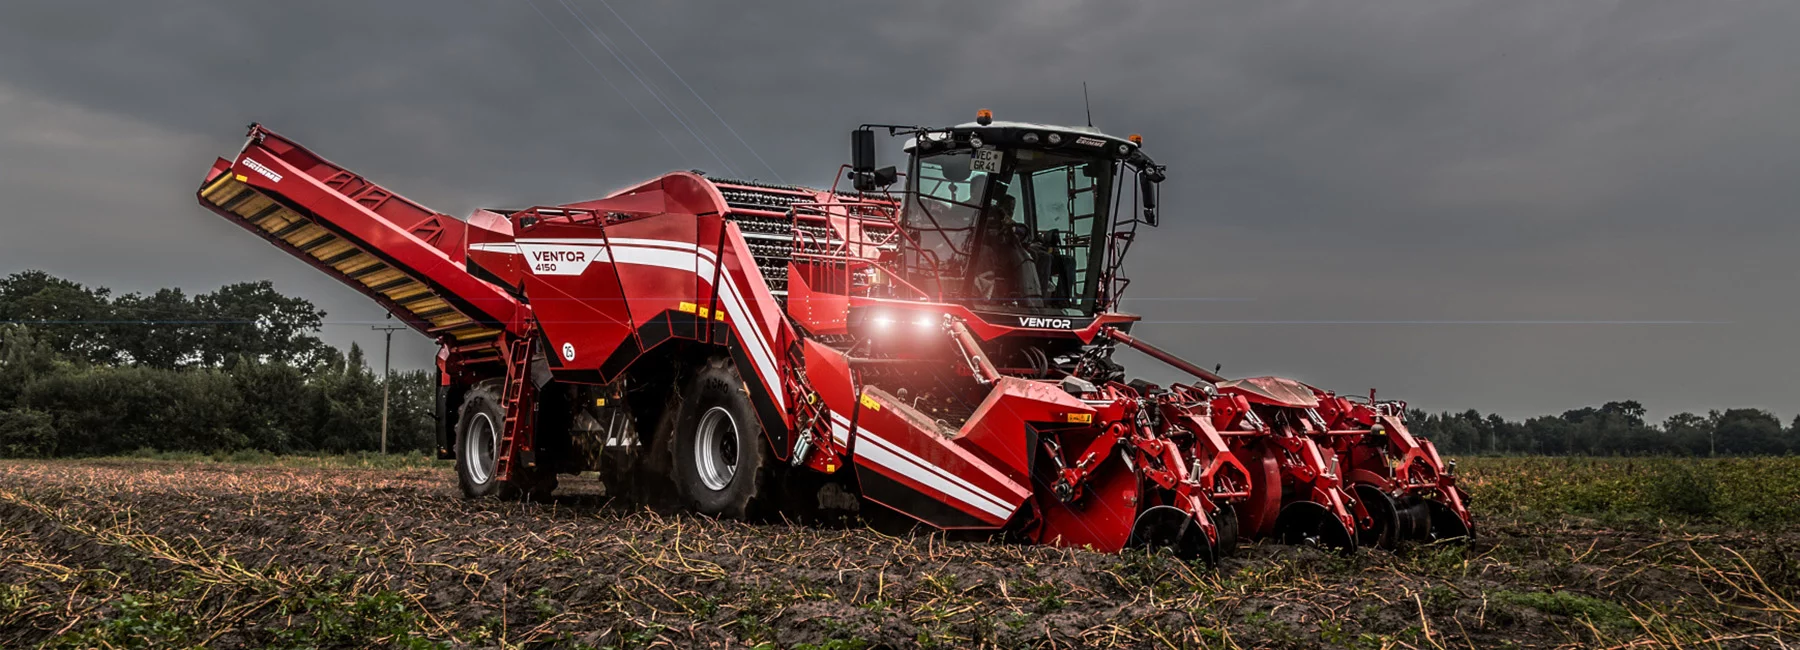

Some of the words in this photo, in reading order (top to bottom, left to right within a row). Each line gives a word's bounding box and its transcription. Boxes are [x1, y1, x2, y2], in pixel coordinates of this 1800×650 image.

[976, 150, 992, 160] VEC
[242, 157, 283, 183] GRIMME
[973, 160, 985, 170] GR
[985, 161, 996, 172] 41
[532, 251, 585, 262] VENTOR
[535, 263, 557, 271] 4150
[1019, 317, 1071, 329] VENTOR
[565, 345, 574, 358] 25
